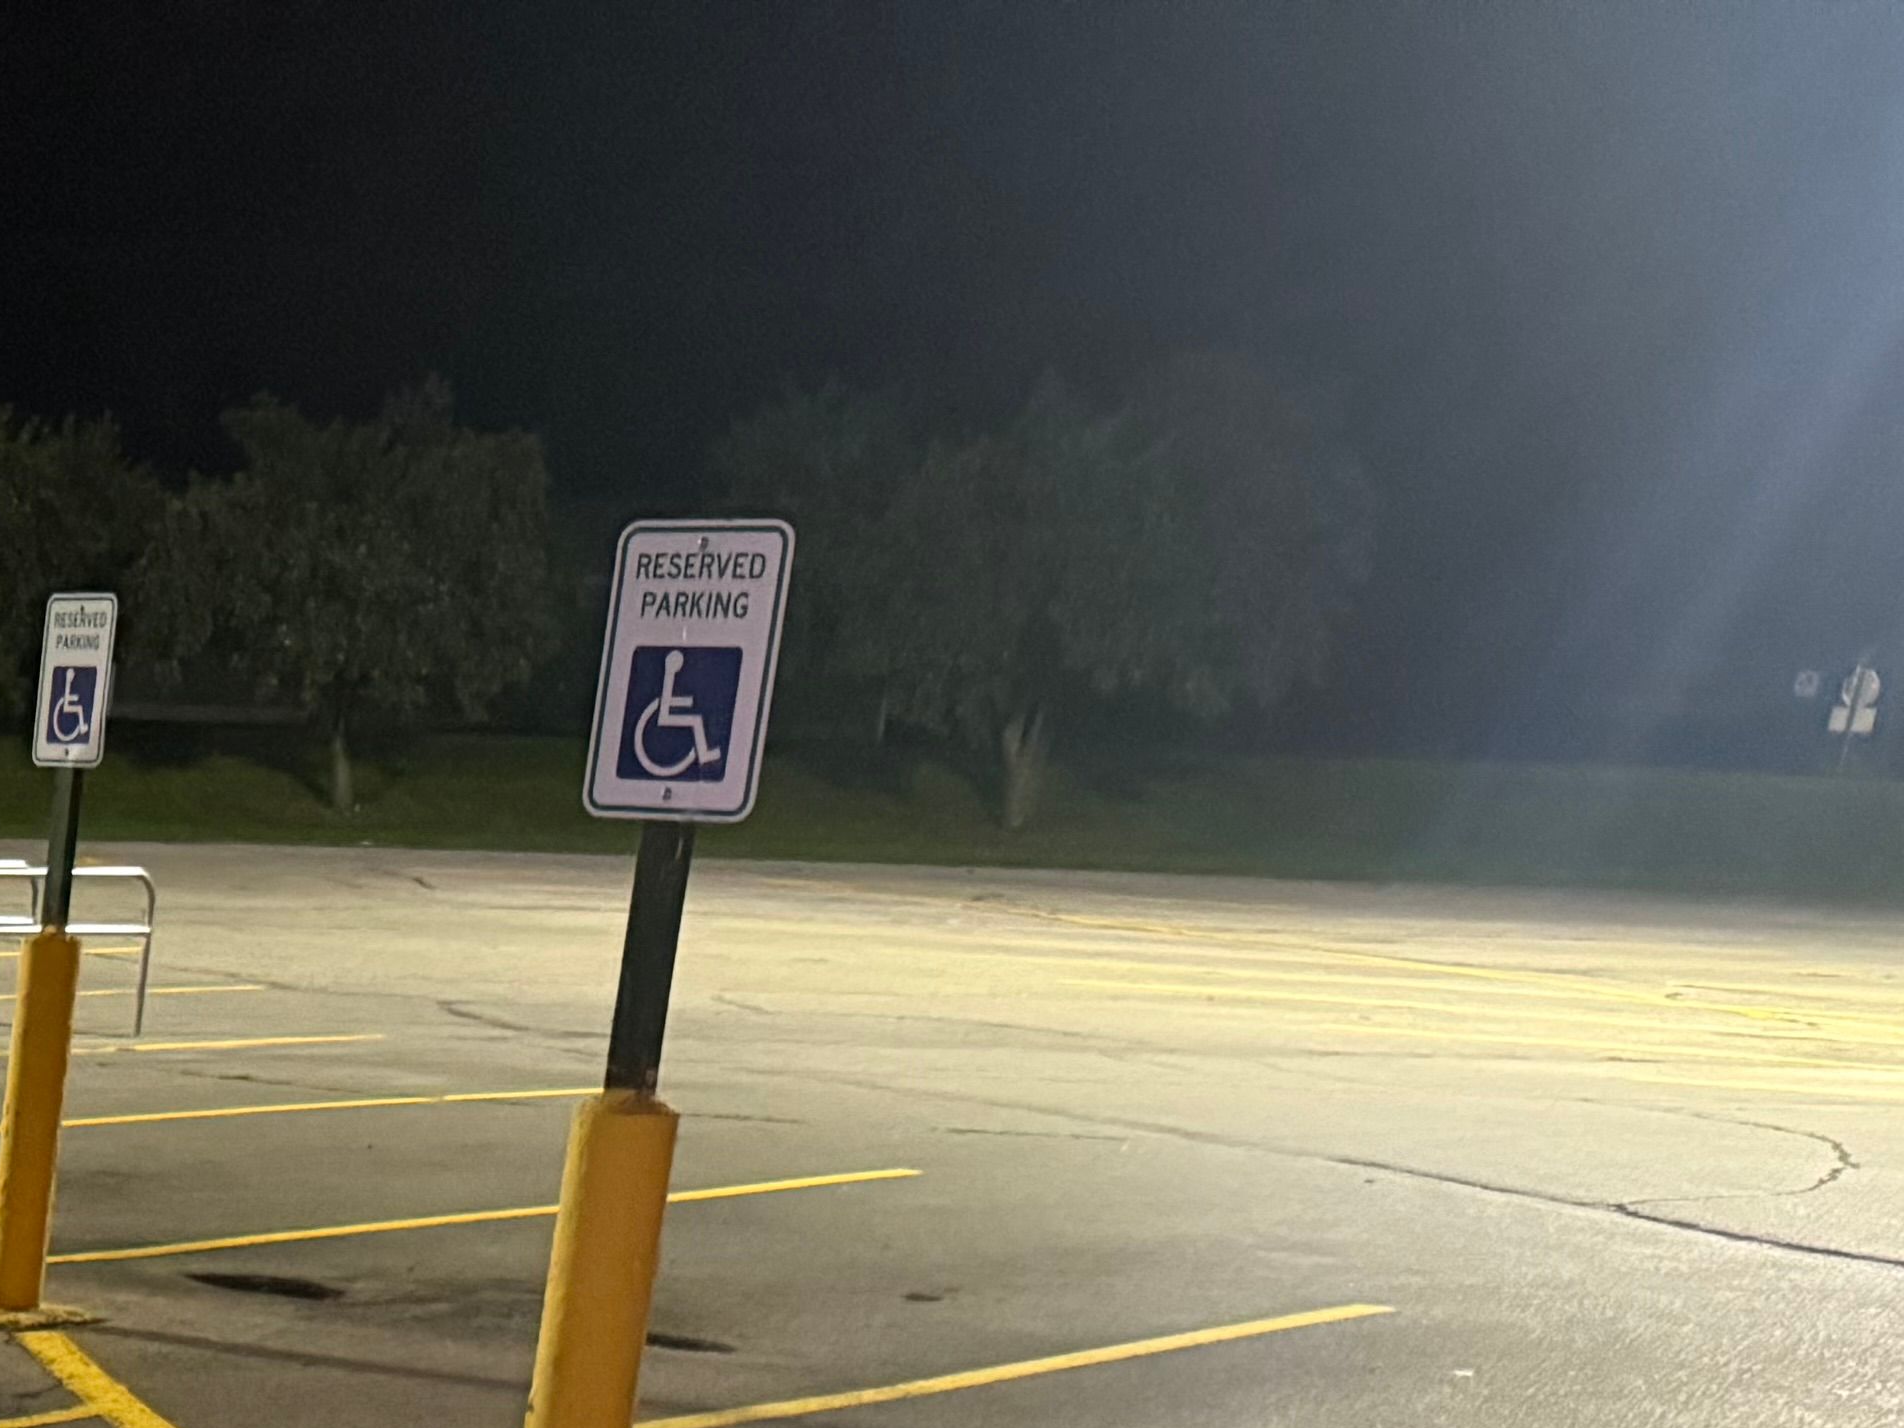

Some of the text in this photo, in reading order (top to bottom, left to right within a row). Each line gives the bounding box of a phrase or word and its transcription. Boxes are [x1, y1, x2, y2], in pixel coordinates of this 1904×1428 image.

[636, 552, 766, 580] RESERVED
[640, 591, 749, 619] PARKING
[53, 611, 109, 629] RESERVED
[55, 633, 100, 651] PARKING
